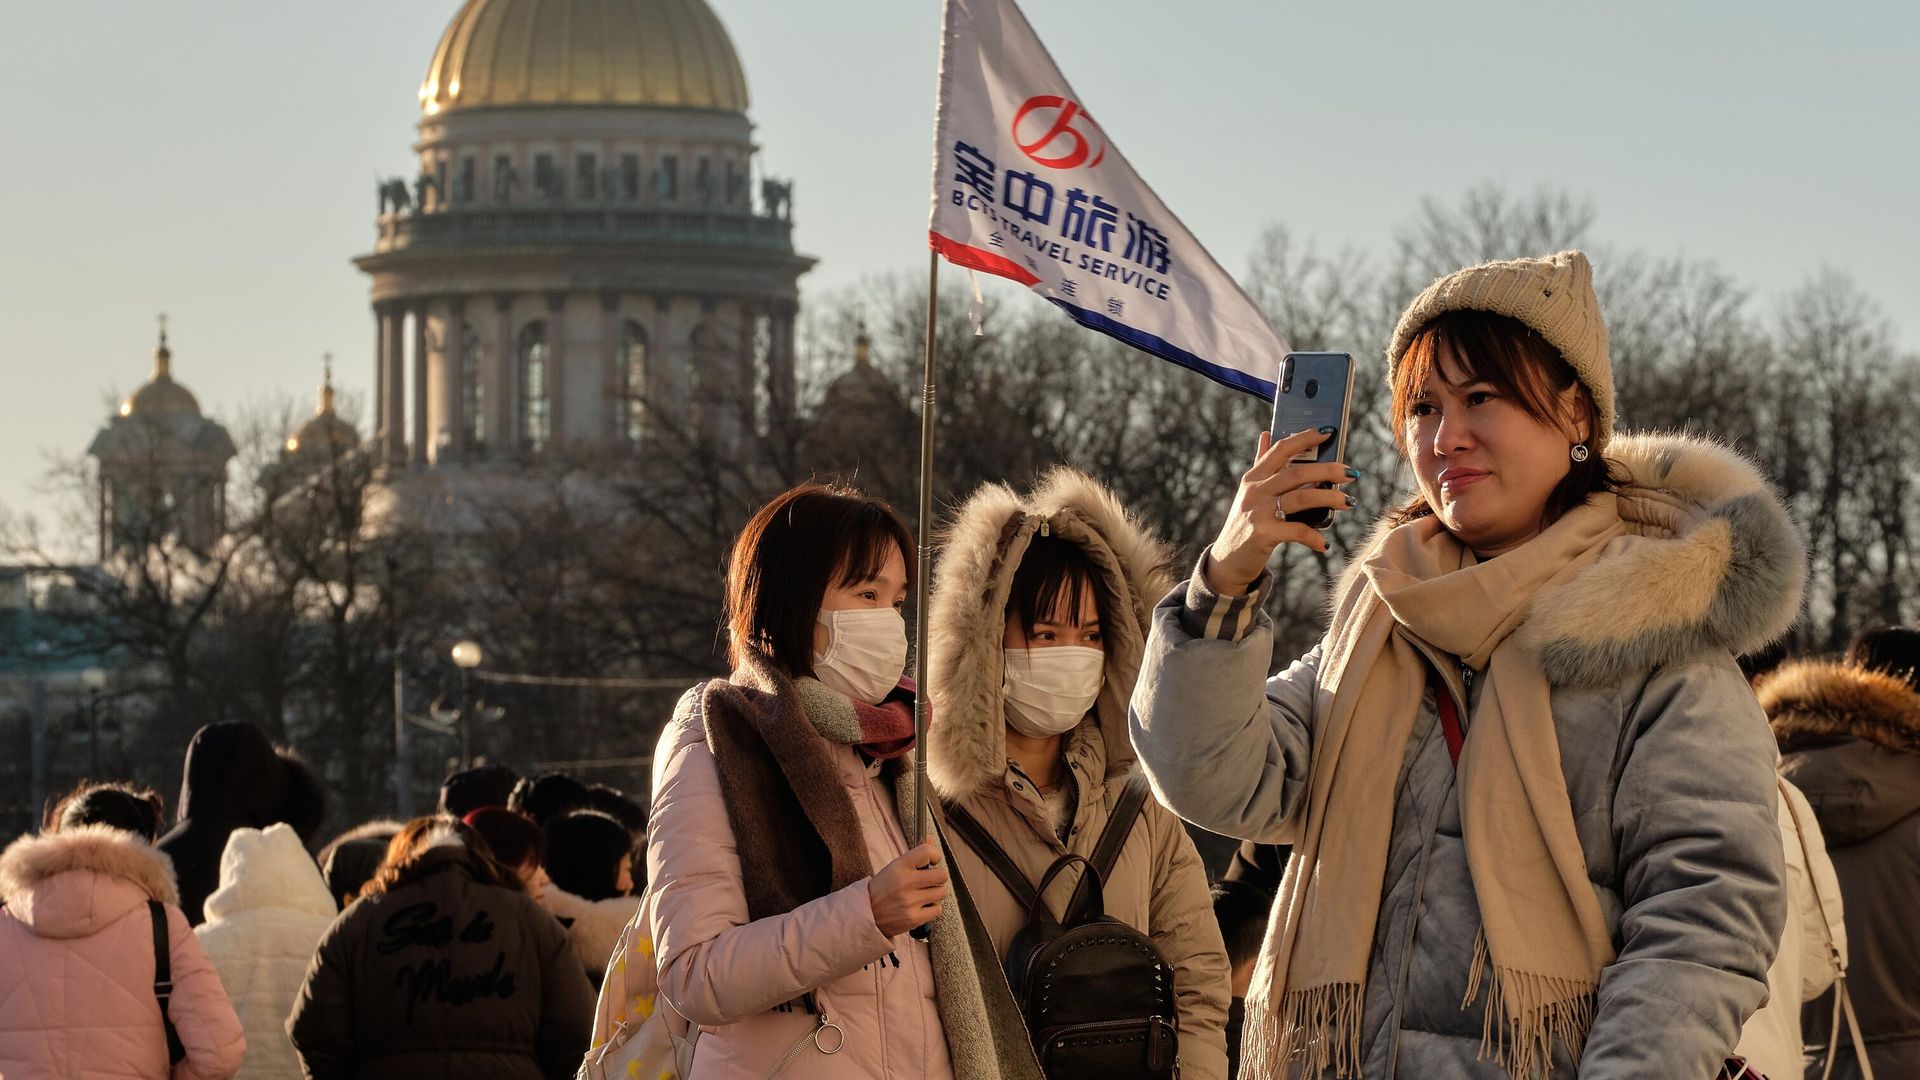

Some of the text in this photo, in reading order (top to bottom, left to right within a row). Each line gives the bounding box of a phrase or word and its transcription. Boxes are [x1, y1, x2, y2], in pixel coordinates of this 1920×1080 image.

[951, 189, 1170, 301] BCTS TRAVEL SERVICE
[954, 140, 1172, 276] 宝中旅游
